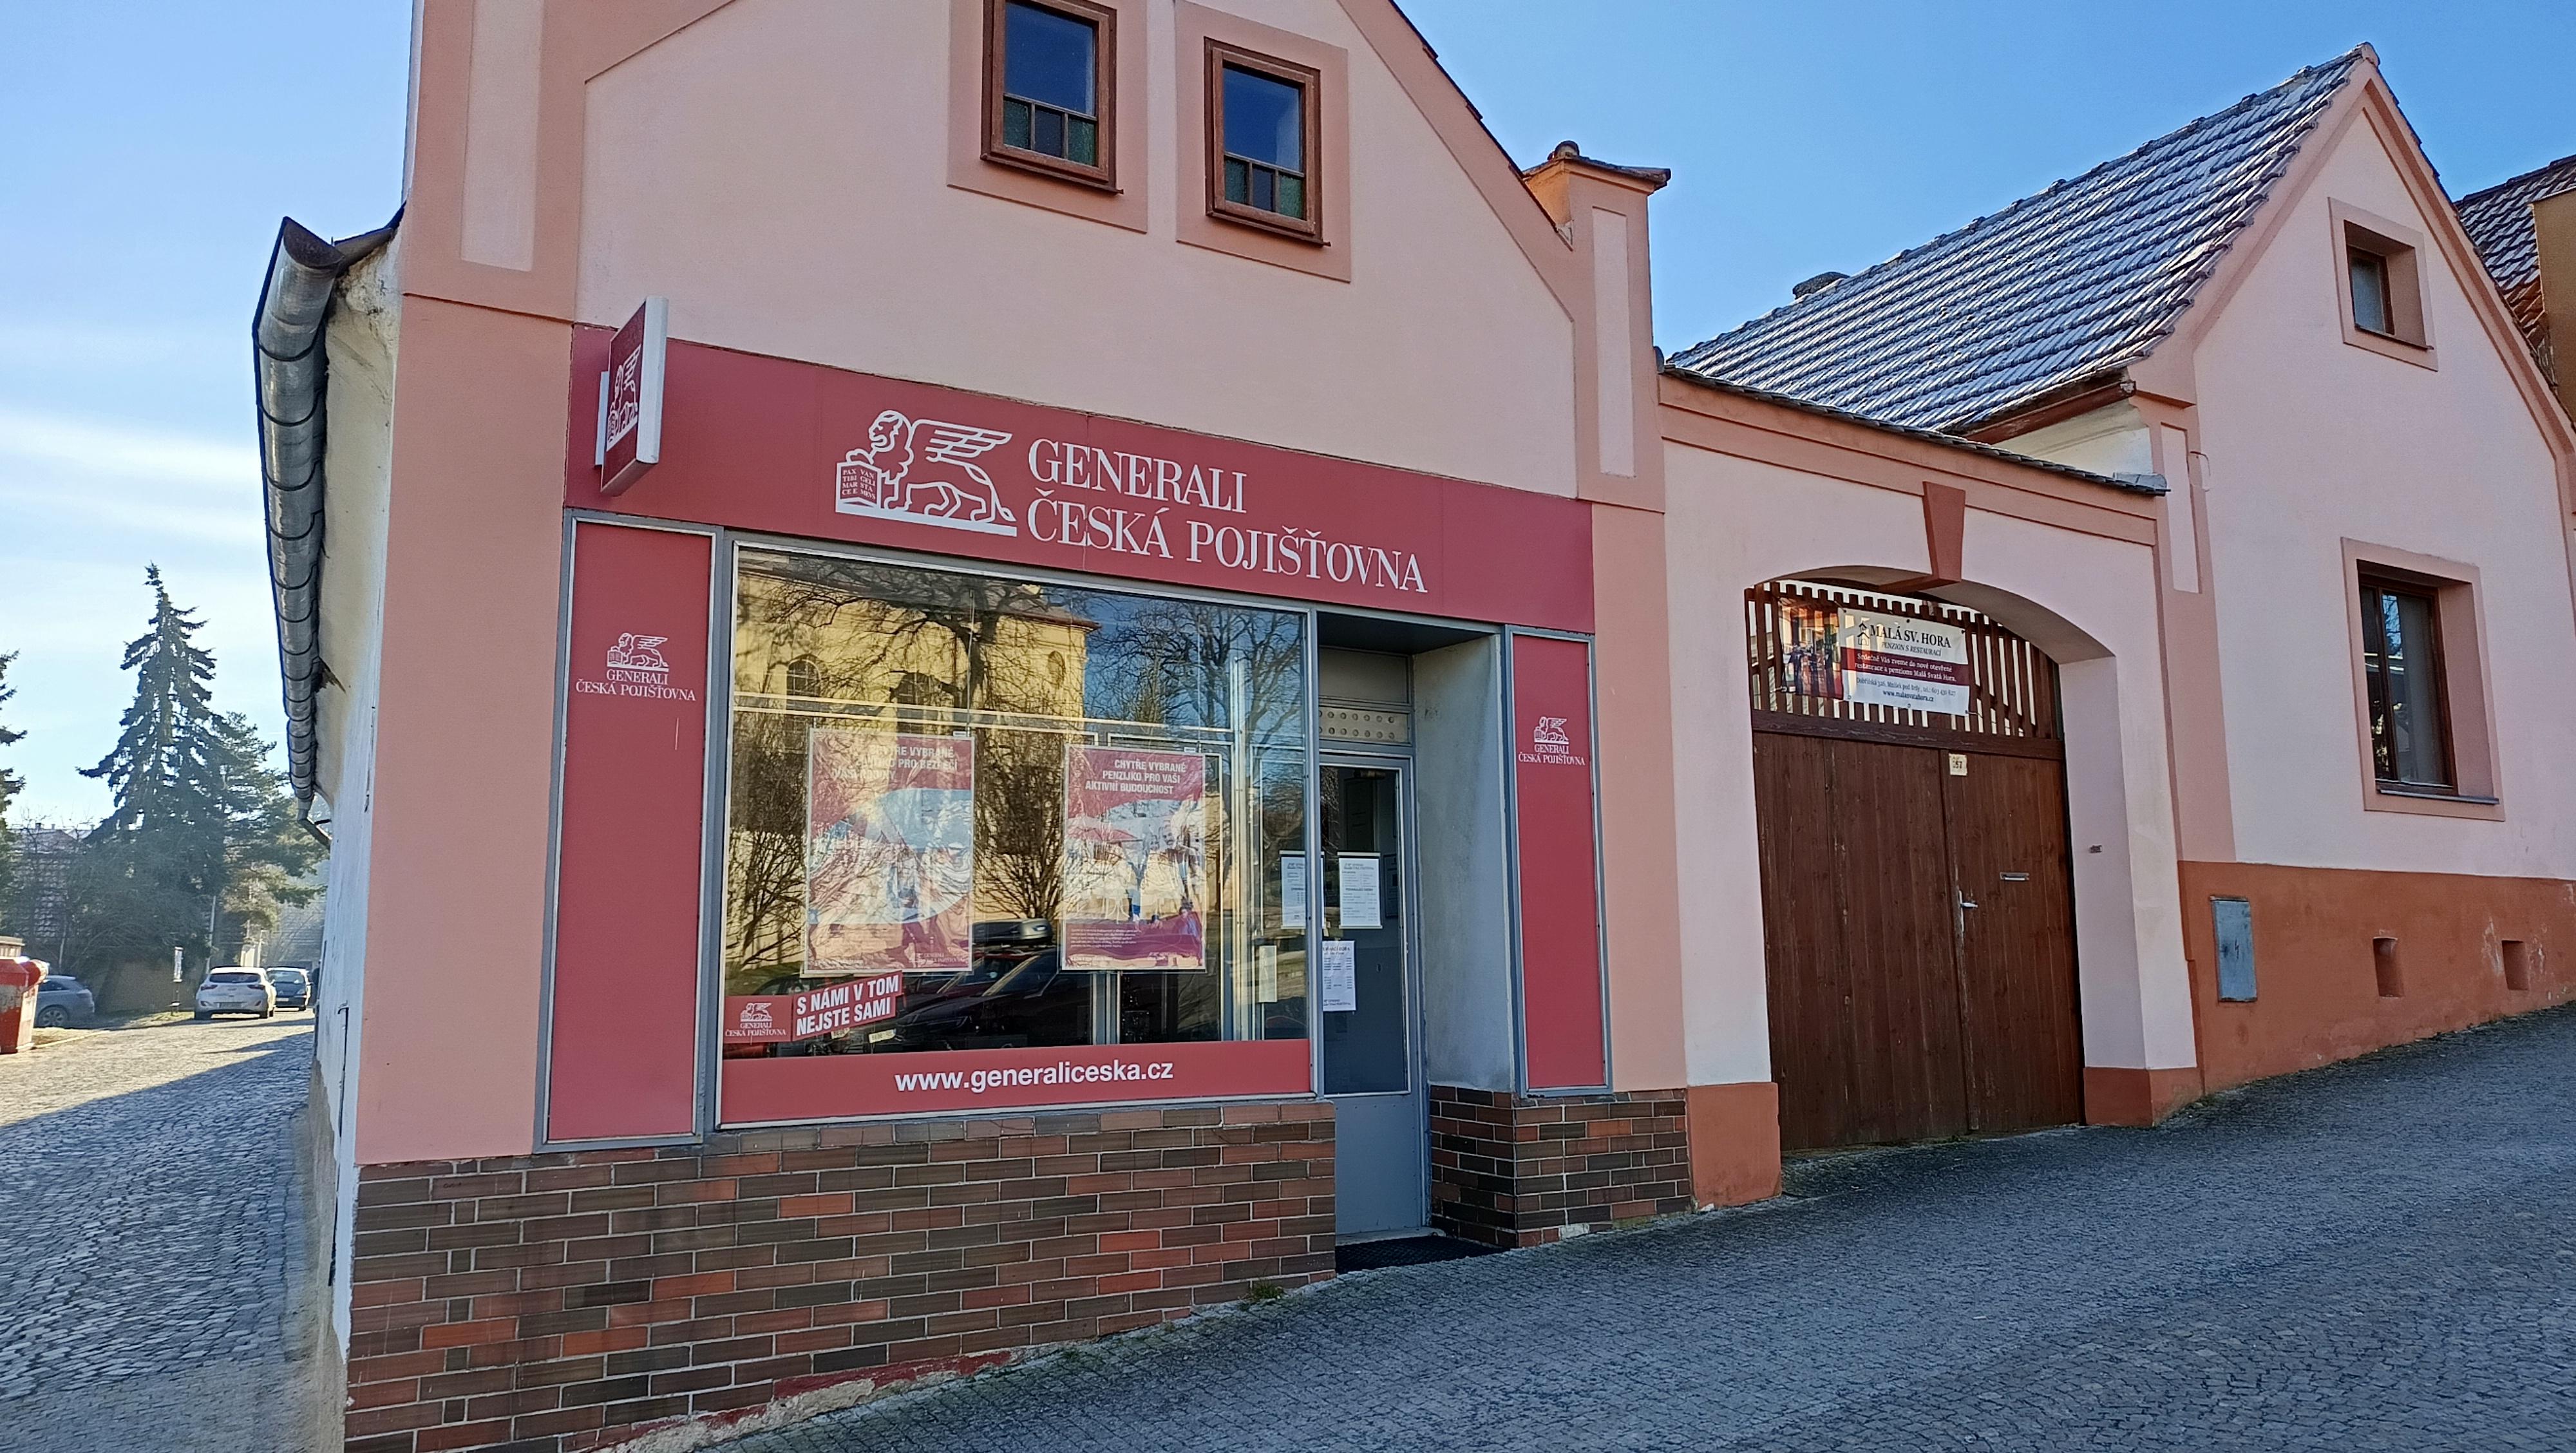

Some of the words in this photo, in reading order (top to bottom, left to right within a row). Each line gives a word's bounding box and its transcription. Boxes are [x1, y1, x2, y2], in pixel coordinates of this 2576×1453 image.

[1028, 439, 1247, 513] GENERALI
[1028, 487, 1173, 558] ČESKÁ
[1186, 520, 1428, 593] POJIŠŤOVNA
[1870, 625, 1902, 641] MALÁ
[1904, 630, 1919, 643] SV.
[1922, 632, 1951, 648] HORA
[1882, 641, 1904, 651] PENZION
[607, 669, 668, 685] GENERALI
[576, 678, 616, 695] ČESKÁ
[621, 684, 696, 701] POJIŠŤOVNA
[1534, 743, 1569, 754] GENERALI
[897, 758, 917, 769] PRO
[1114, 758, 1146, 770] CHYTŘE
[1148, 759, 1187, 773] VYBRANÉ
[1519, 752, 1542, 763] ČESKÁ
[1542, 754, 1586, 765] POJIŠŤOVNA
[1102, 770, 1142, 781] PENZIJKO
[1144, 773, 1160, 783] PRO
[1084, 781, 1118, 792] AKTIVNÍ
[1119, 783, 1174, 795] BUDOUCNOST
[797, 996, 806, 1015] S
[810, 986, 849, 1011] NÁMI
[853, 983, 864, 1002] V
[867, 974, 900, 996] TOM
[796, 1007, 850, 1036] NEJSTE
[854, 997, 891, 1023] SAMI
[725, 1028, 747, 1037] ČESKÁ
[740, 1021, 772, 1030] GENERALI
[895, 1059, 1173, 1094] www.generaliceska.cz
